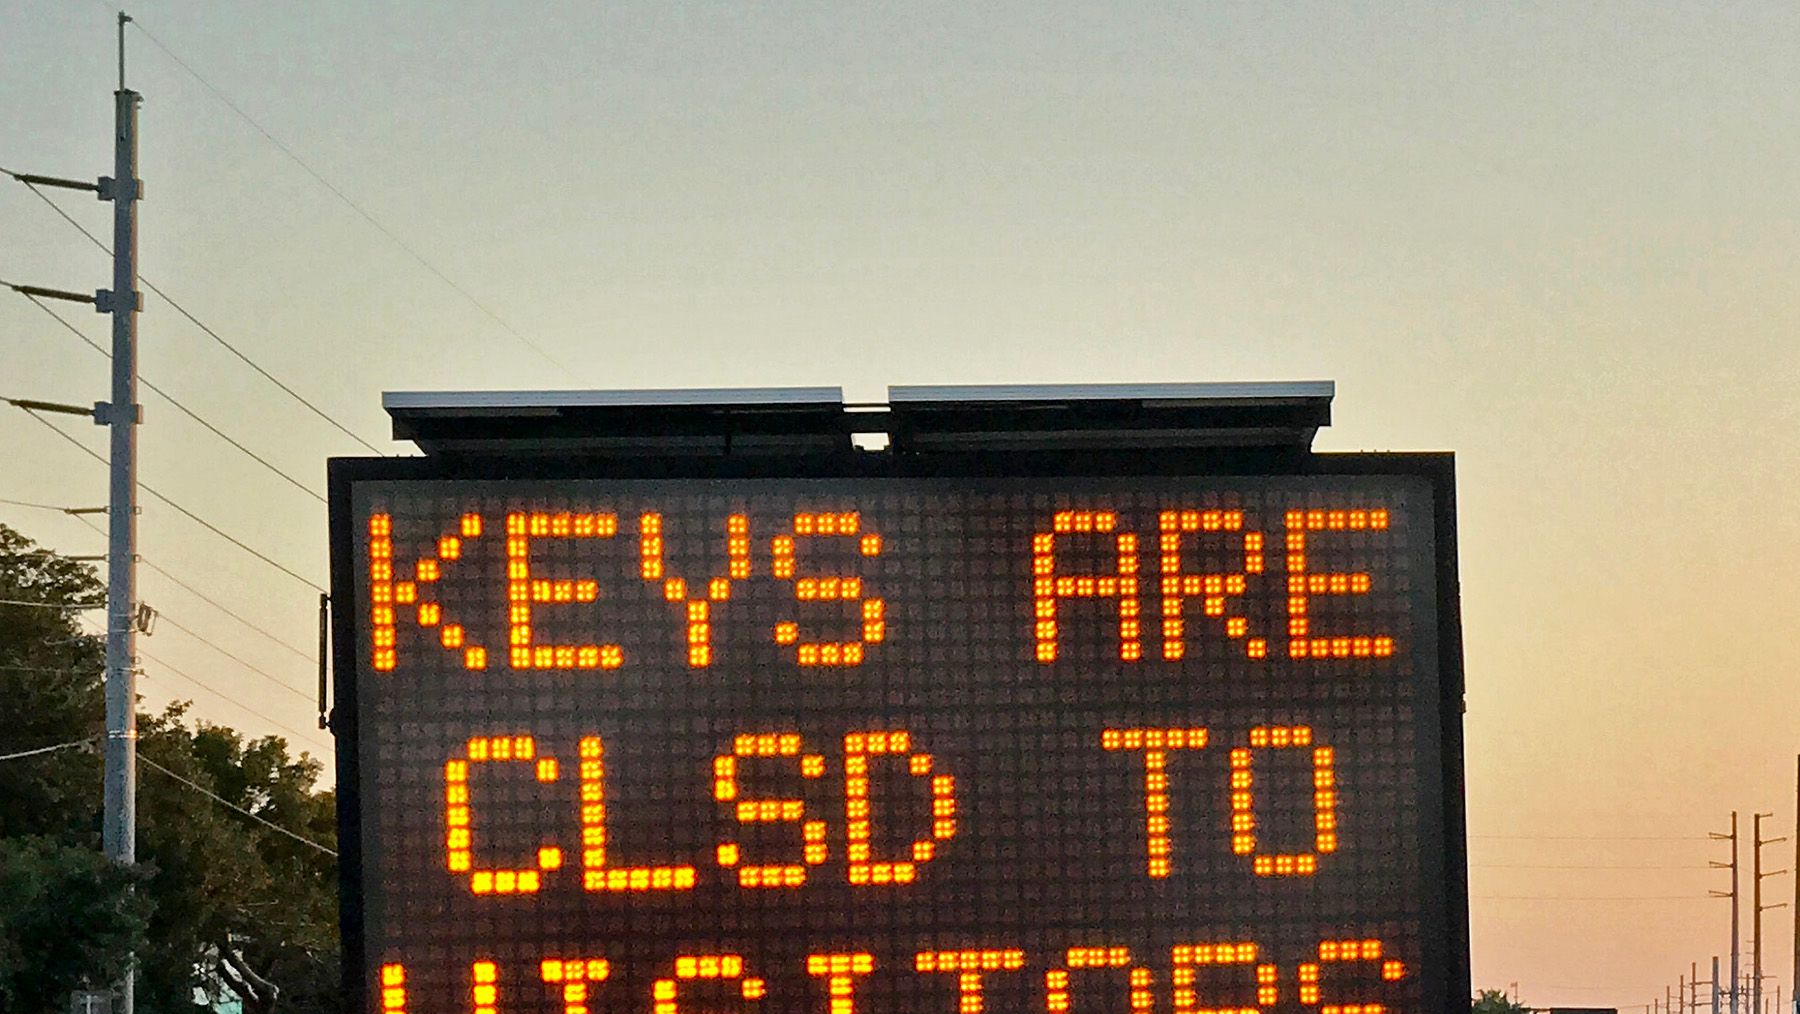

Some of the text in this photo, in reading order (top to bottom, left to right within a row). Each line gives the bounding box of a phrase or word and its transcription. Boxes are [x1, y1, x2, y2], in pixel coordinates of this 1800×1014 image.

[368, 508, 1395, 672] KEYS ARE
[443, 725, 1339, 896] CLSD TO
